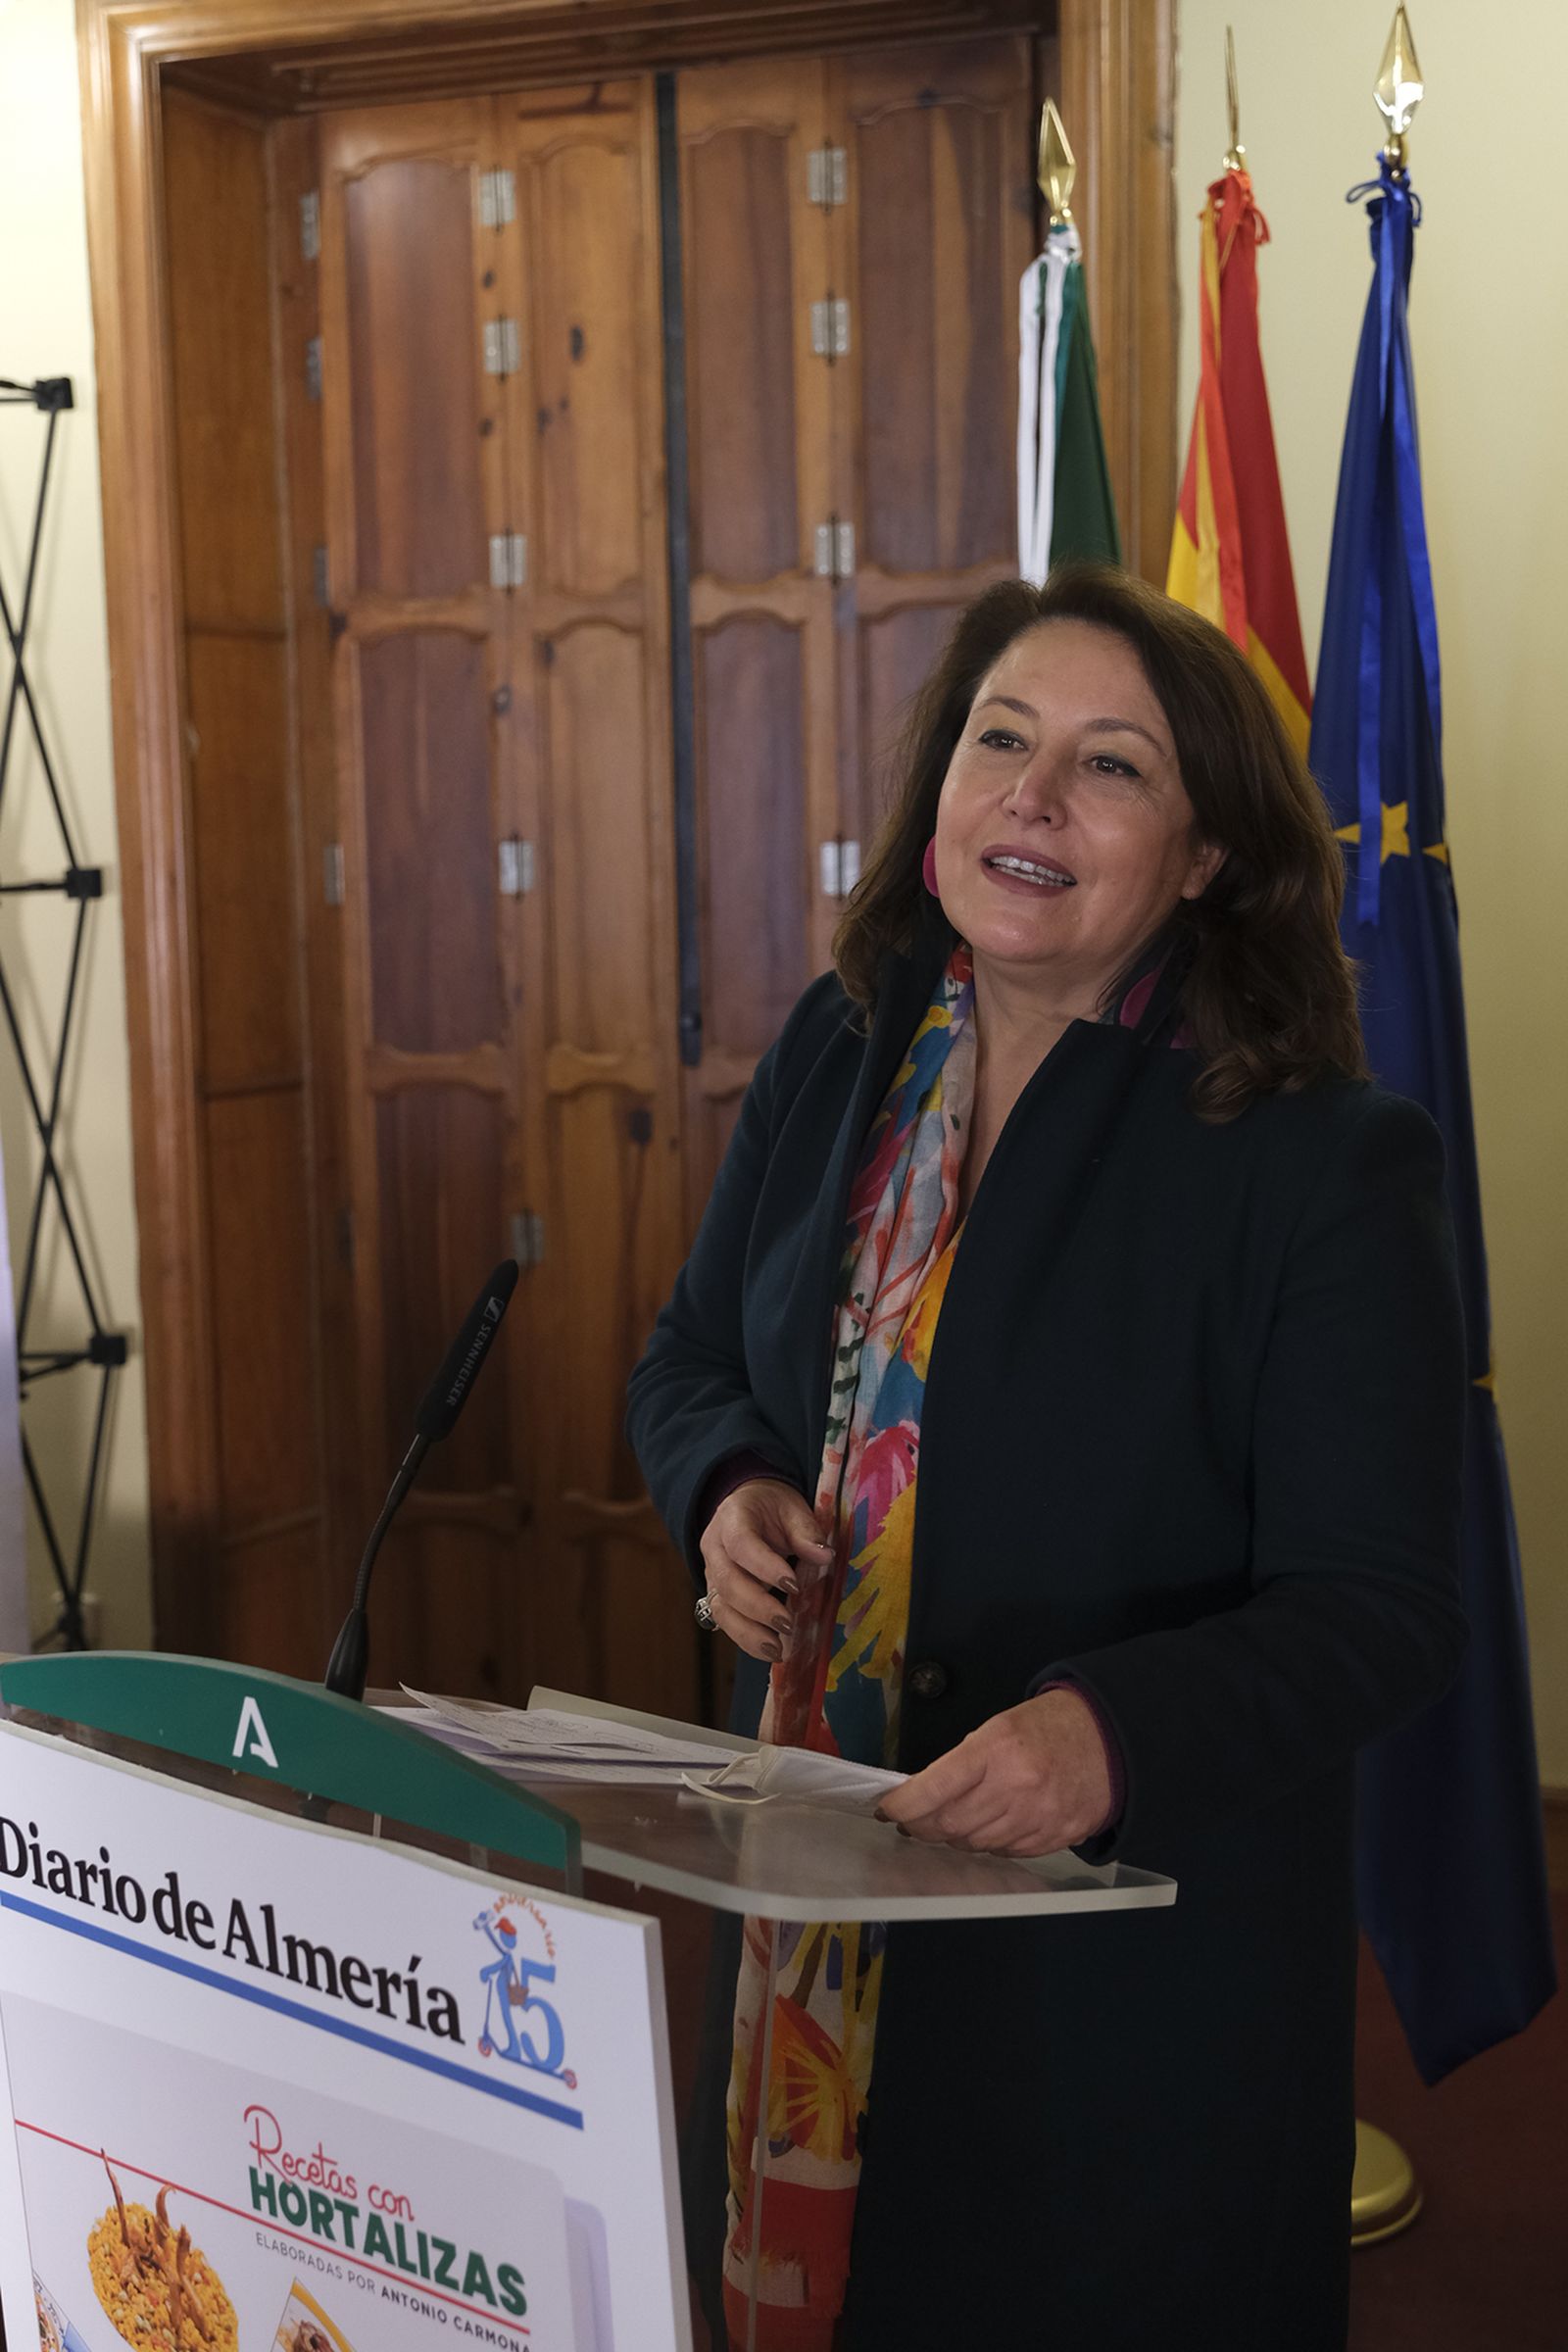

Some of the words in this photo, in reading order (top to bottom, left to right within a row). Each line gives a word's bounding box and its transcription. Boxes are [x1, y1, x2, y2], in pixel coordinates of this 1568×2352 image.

[446, 1323, 492, 1406] SENNHEISER
[232, 1695, 279, 1769] A
[0, 1816, 147, 1924] Diario
[152, 1871, 217, 1950] de
[221, 1897, 466, 2046] Almería
[244, 2104, 358, 2200] Recetas
[368, 2183, 415, 2222] con
[248, 2165, 528, 2317] HORTALIZAS
[256, 2231, 343, 2279] ELABORADAS
[347, 2270, 375, 2294] POR
[381, 2285, 448, 2324] ANTONIO
[453, 2315, 531, 2352] CARMONA
